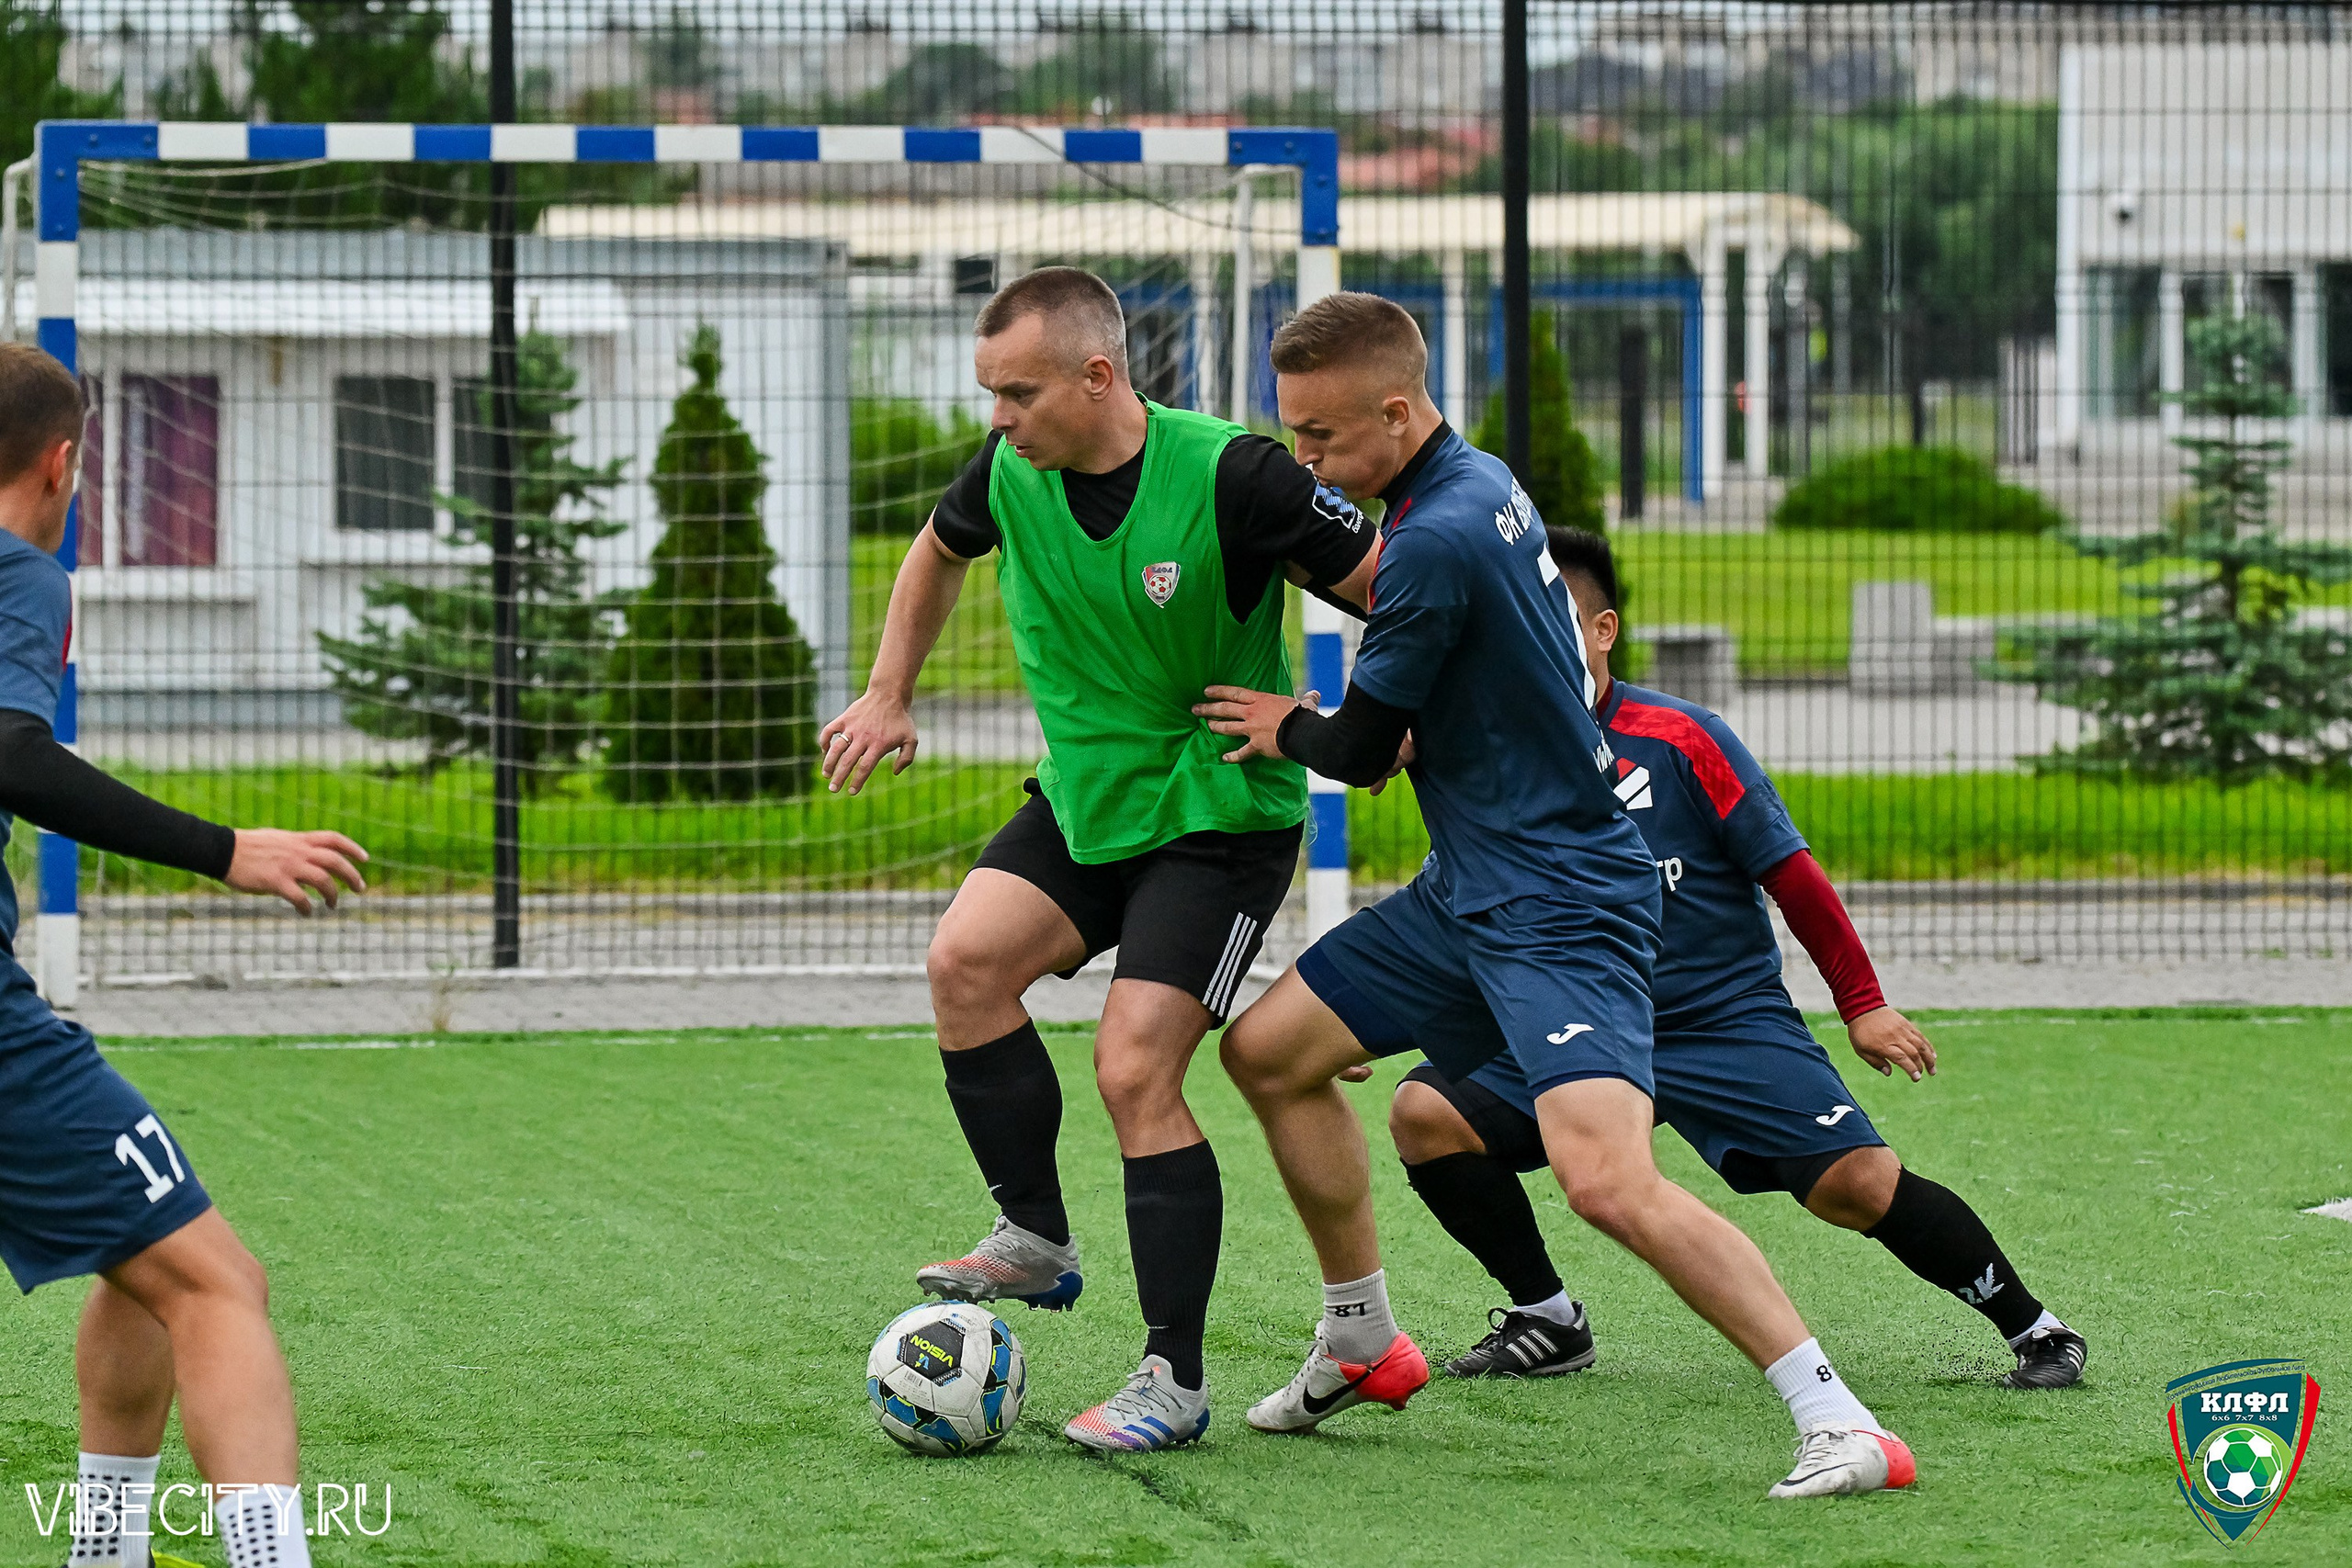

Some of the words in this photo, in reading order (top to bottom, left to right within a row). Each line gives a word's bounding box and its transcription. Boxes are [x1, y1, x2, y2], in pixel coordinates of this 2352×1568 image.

[115, 1113, 186, 1204] 17
[910, 1335, 954, 1368] VISION
[1815, 1363, 1833, 1383] 8
